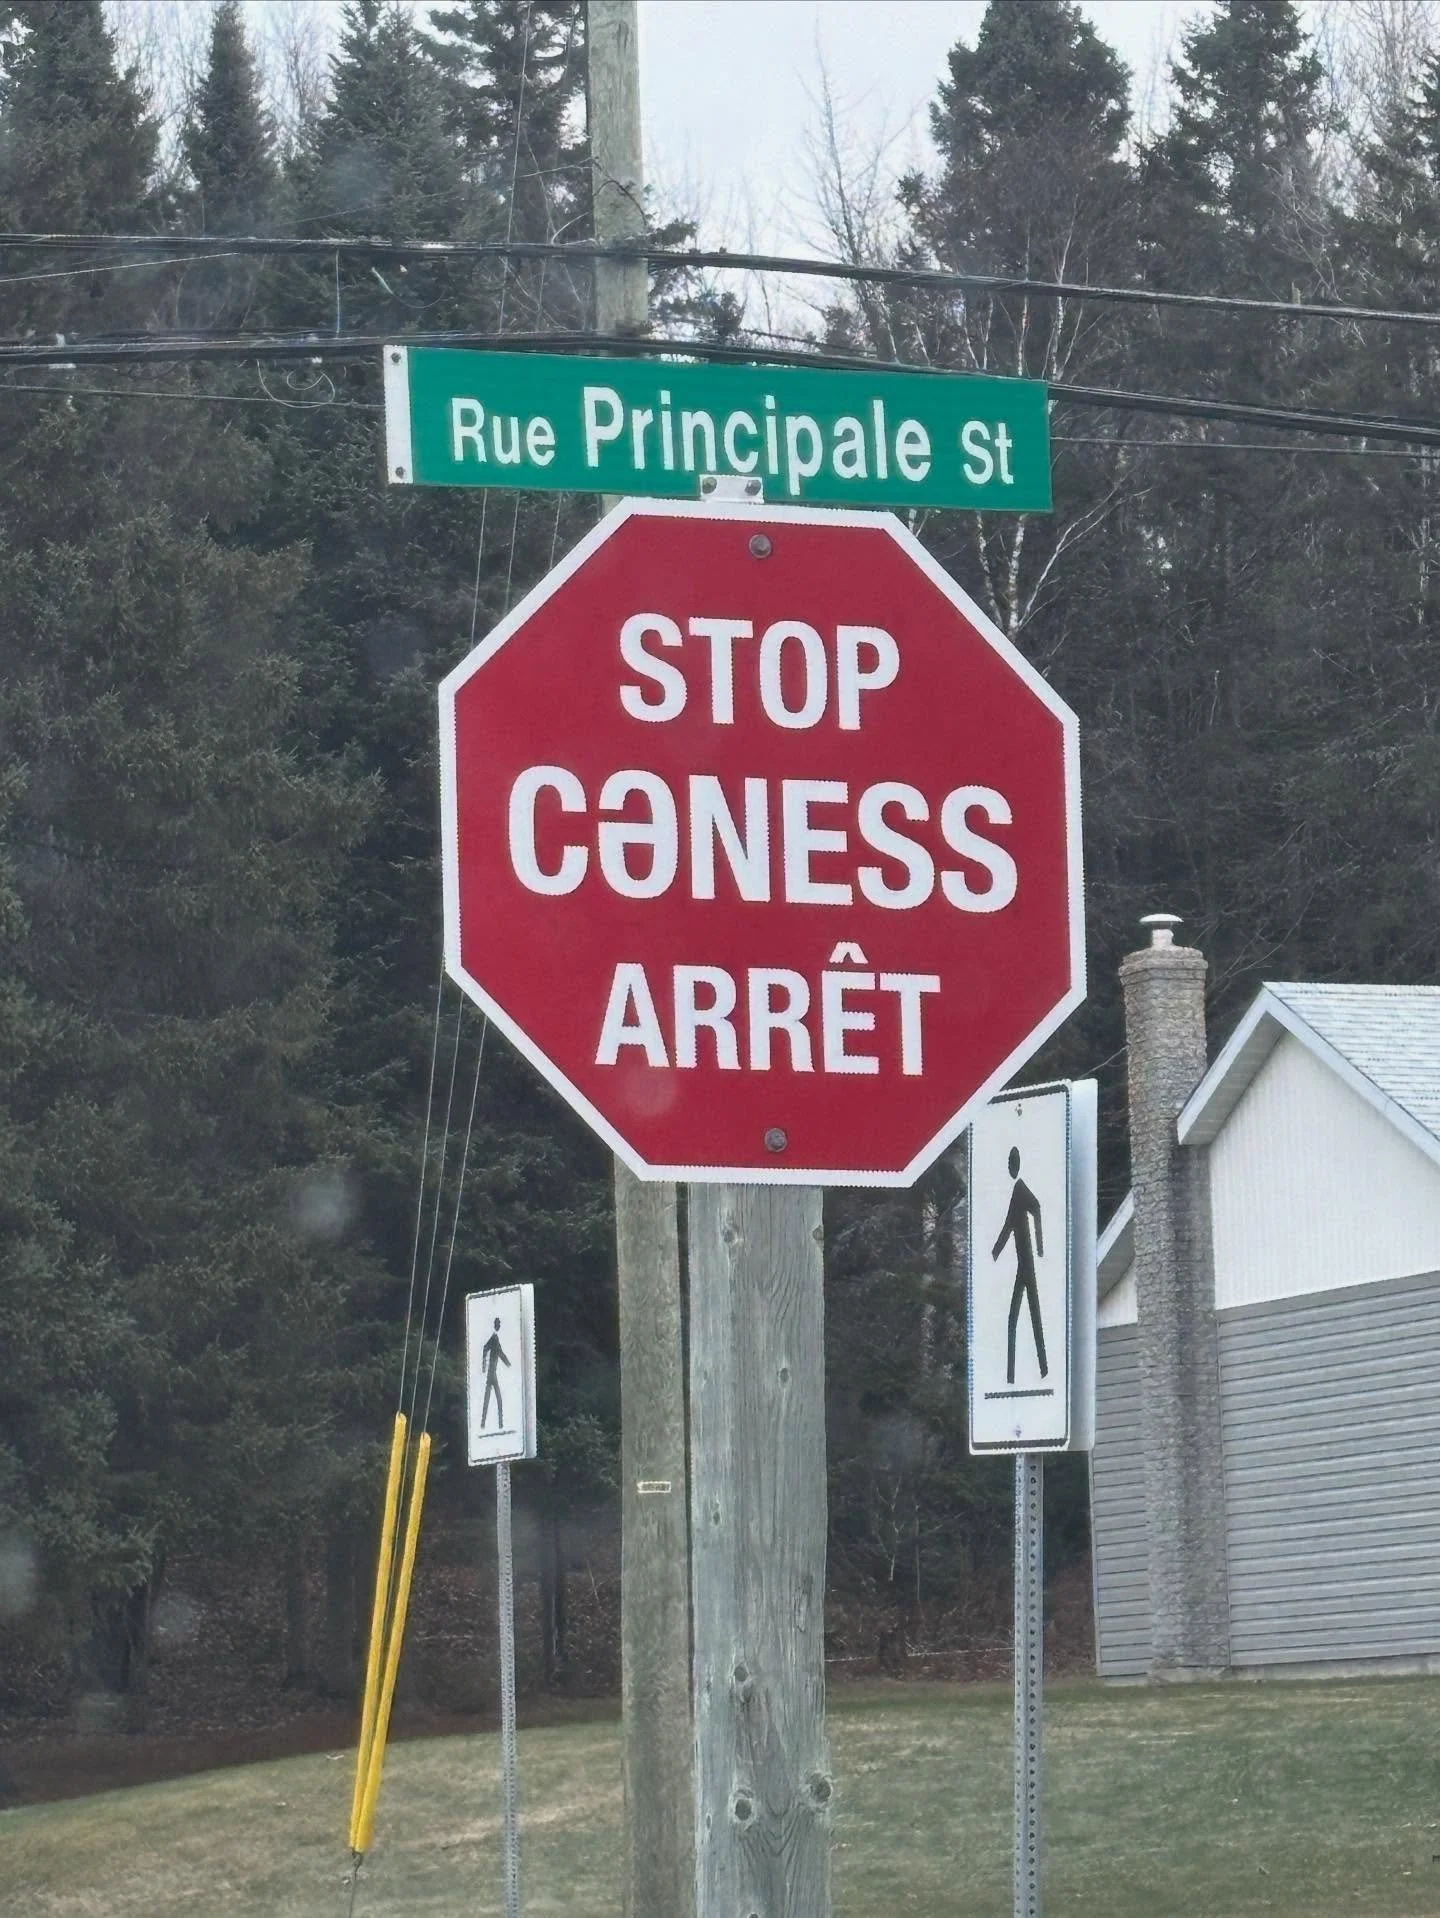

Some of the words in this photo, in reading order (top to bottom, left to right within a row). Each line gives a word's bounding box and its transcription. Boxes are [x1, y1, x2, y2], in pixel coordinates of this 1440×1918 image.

[450, 396, 556, 467] Rue
[583, 386, 931, 497] Principale
[961, 420, 1014, 485] St
[618, 612, 901, 731] STOP
[594, 940, 941, 1077] ARRÊT
